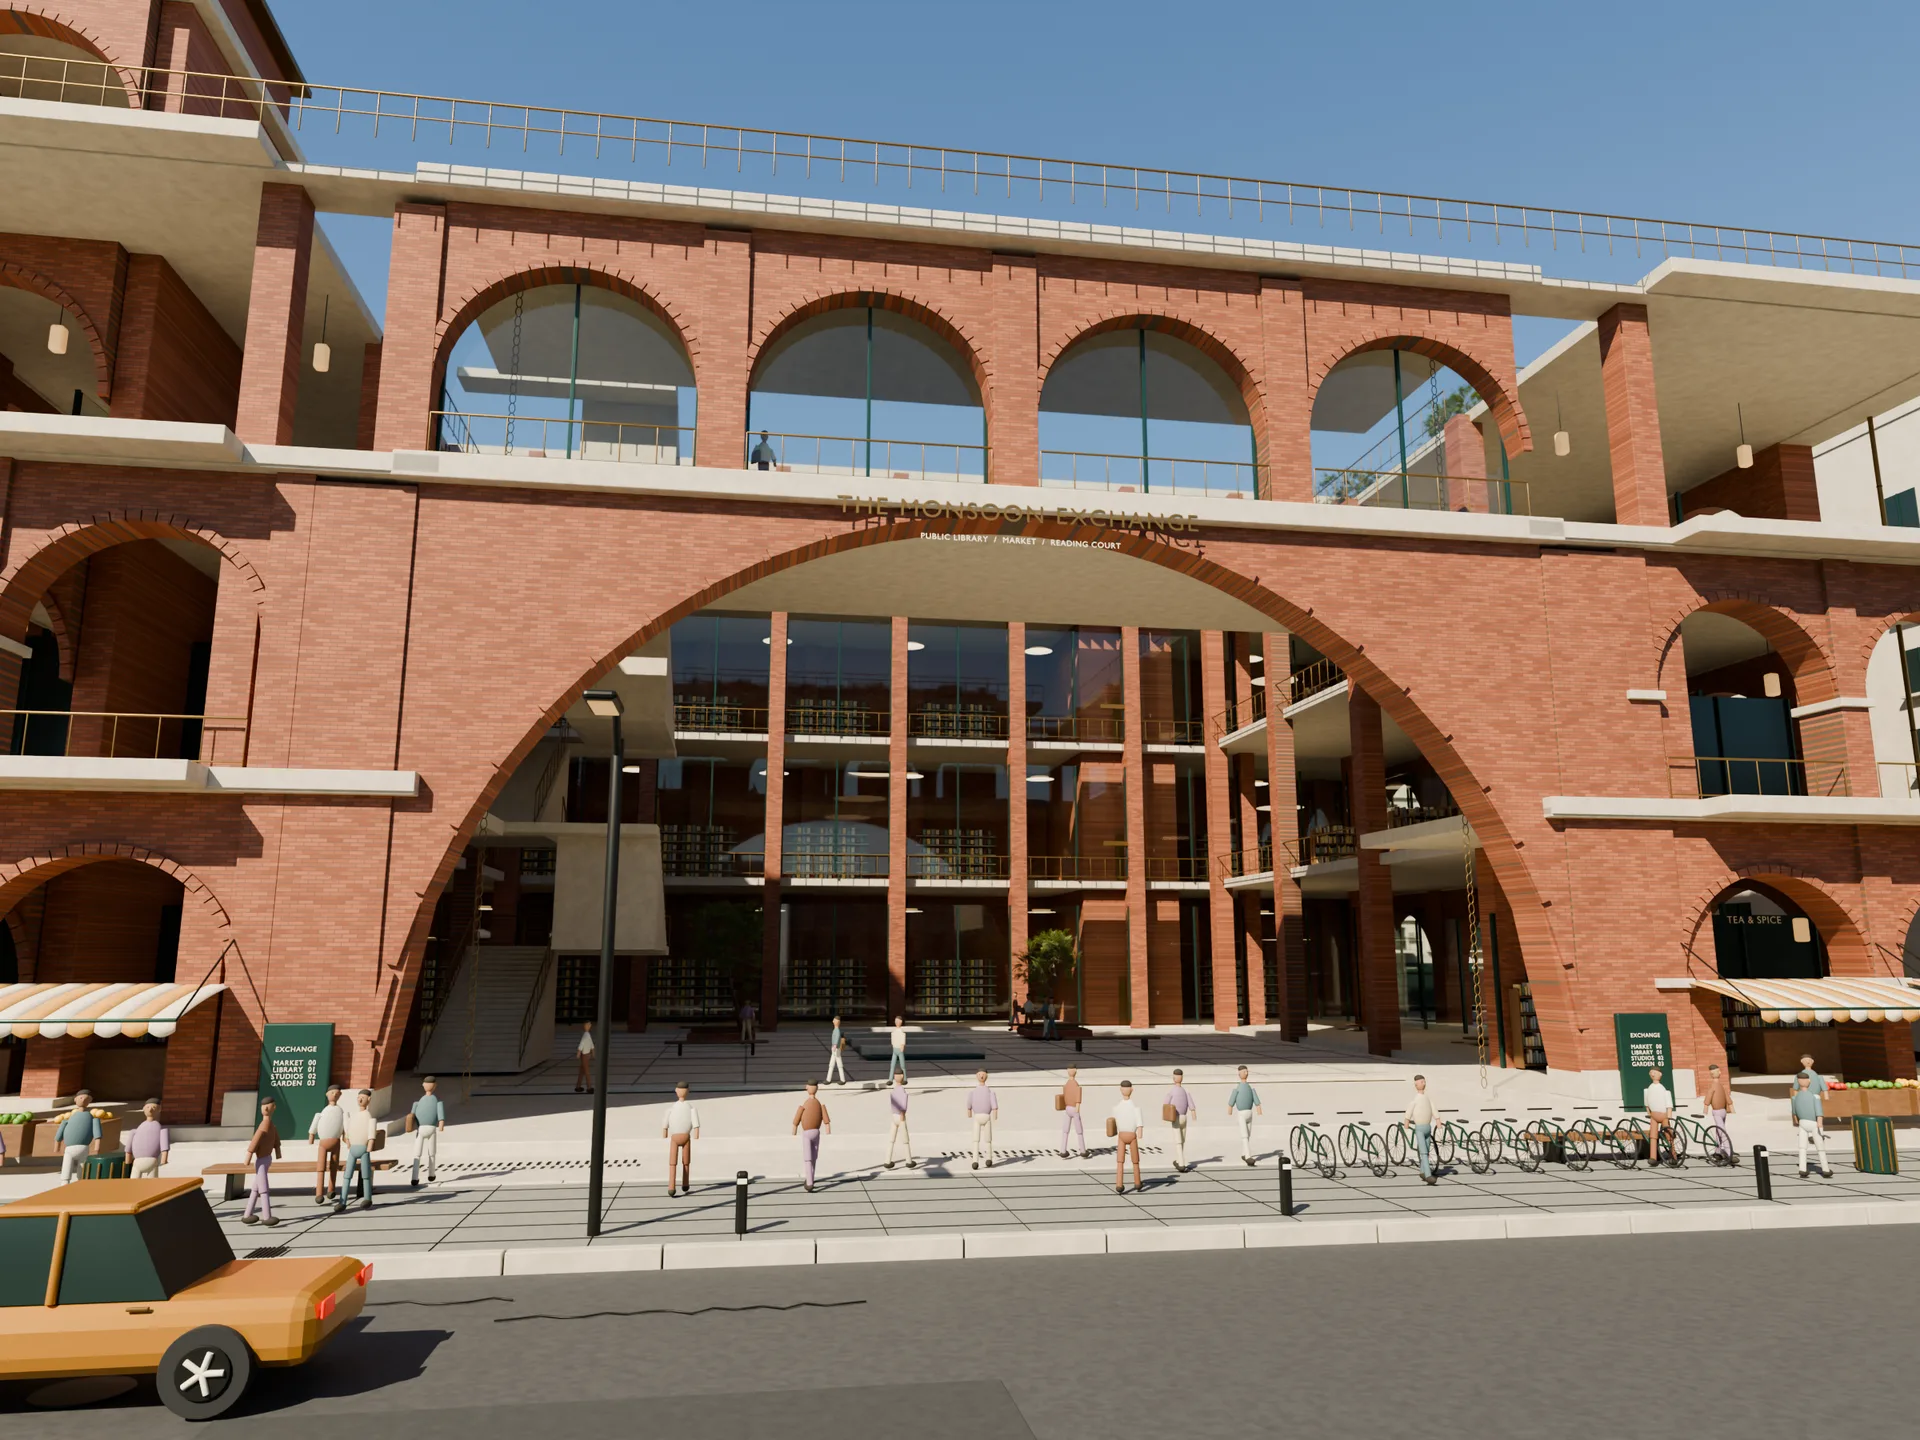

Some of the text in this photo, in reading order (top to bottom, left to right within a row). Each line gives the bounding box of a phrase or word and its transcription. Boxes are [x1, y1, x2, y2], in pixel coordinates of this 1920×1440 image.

[837, 494, 1199, 532] THE MONSOON EXCHANGE
[920, 532, 951, 541] PUBLIC
[953, 534, 989, 543] LIBRARY
[1002, 536, 1037, 545] MARKET
[1050, 539, 1089, 548] READING
[1091, 541, 1122, 550] COURT
[1726, 915, 1782, 924] TEA & SPICE
